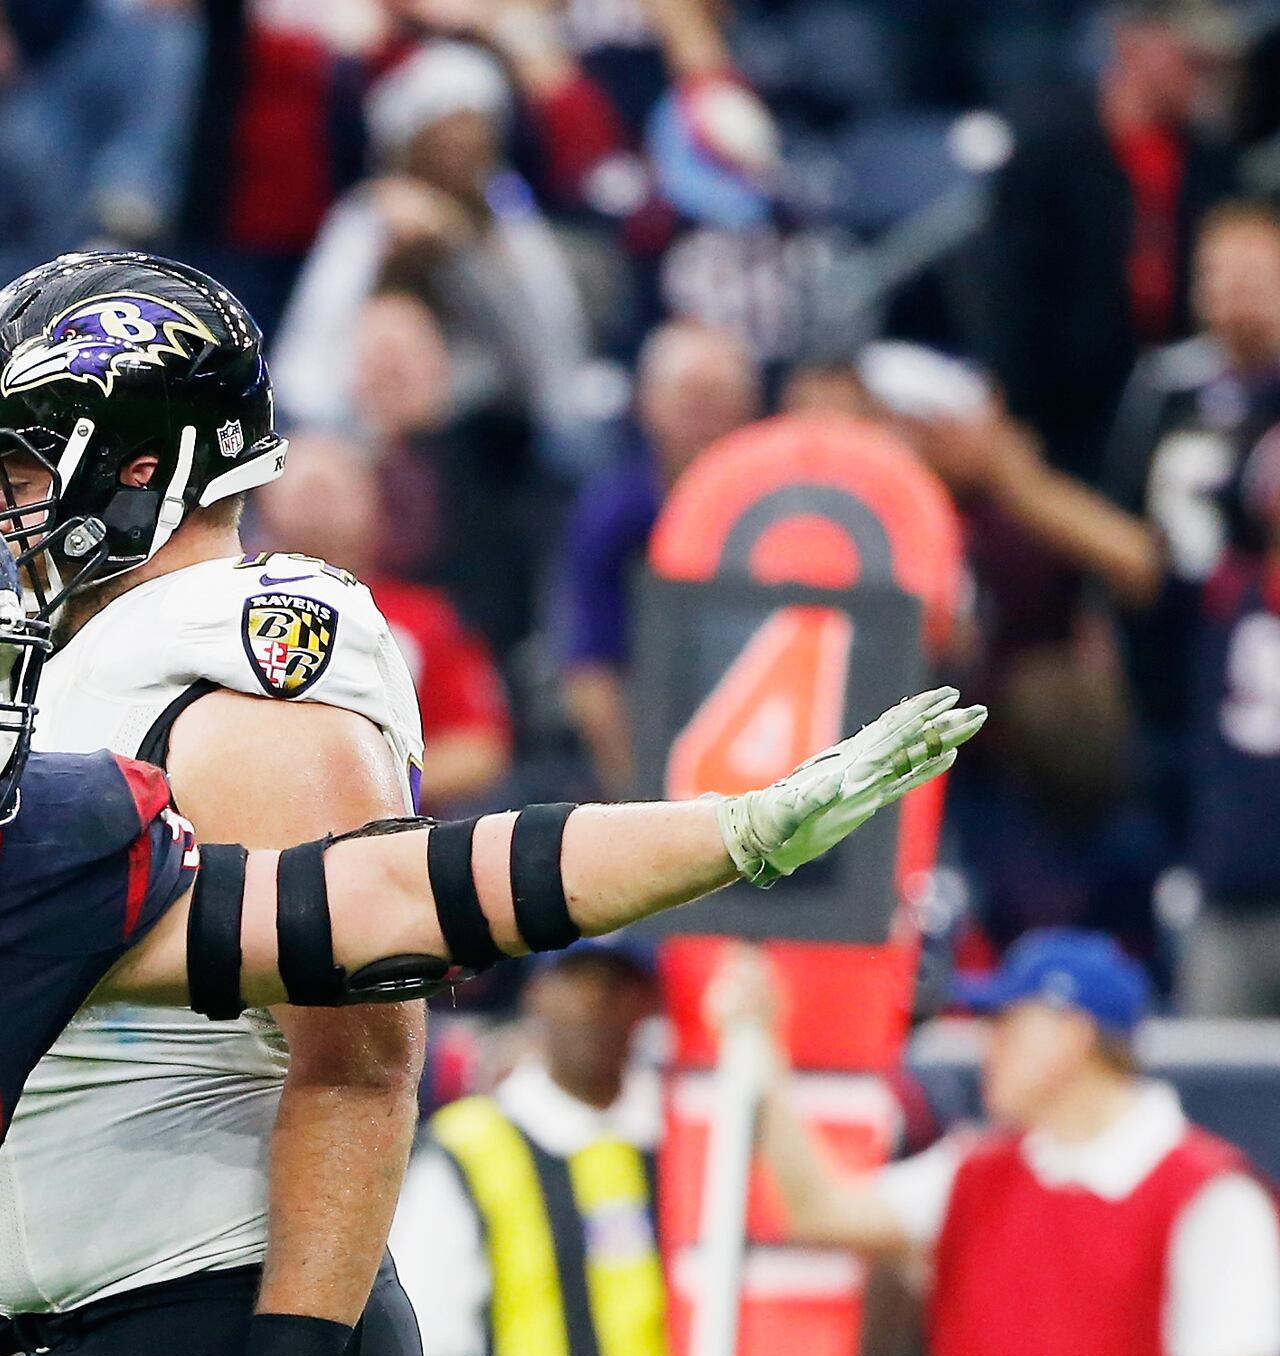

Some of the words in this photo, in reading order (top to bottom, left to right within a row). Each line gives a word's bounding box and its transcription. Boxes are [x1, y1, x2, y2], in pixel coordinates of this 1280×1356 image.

[250, 595, 332, 621] RAVENS
[256, 611, 295, 640] B
[665, 604, 853, 801] 4
